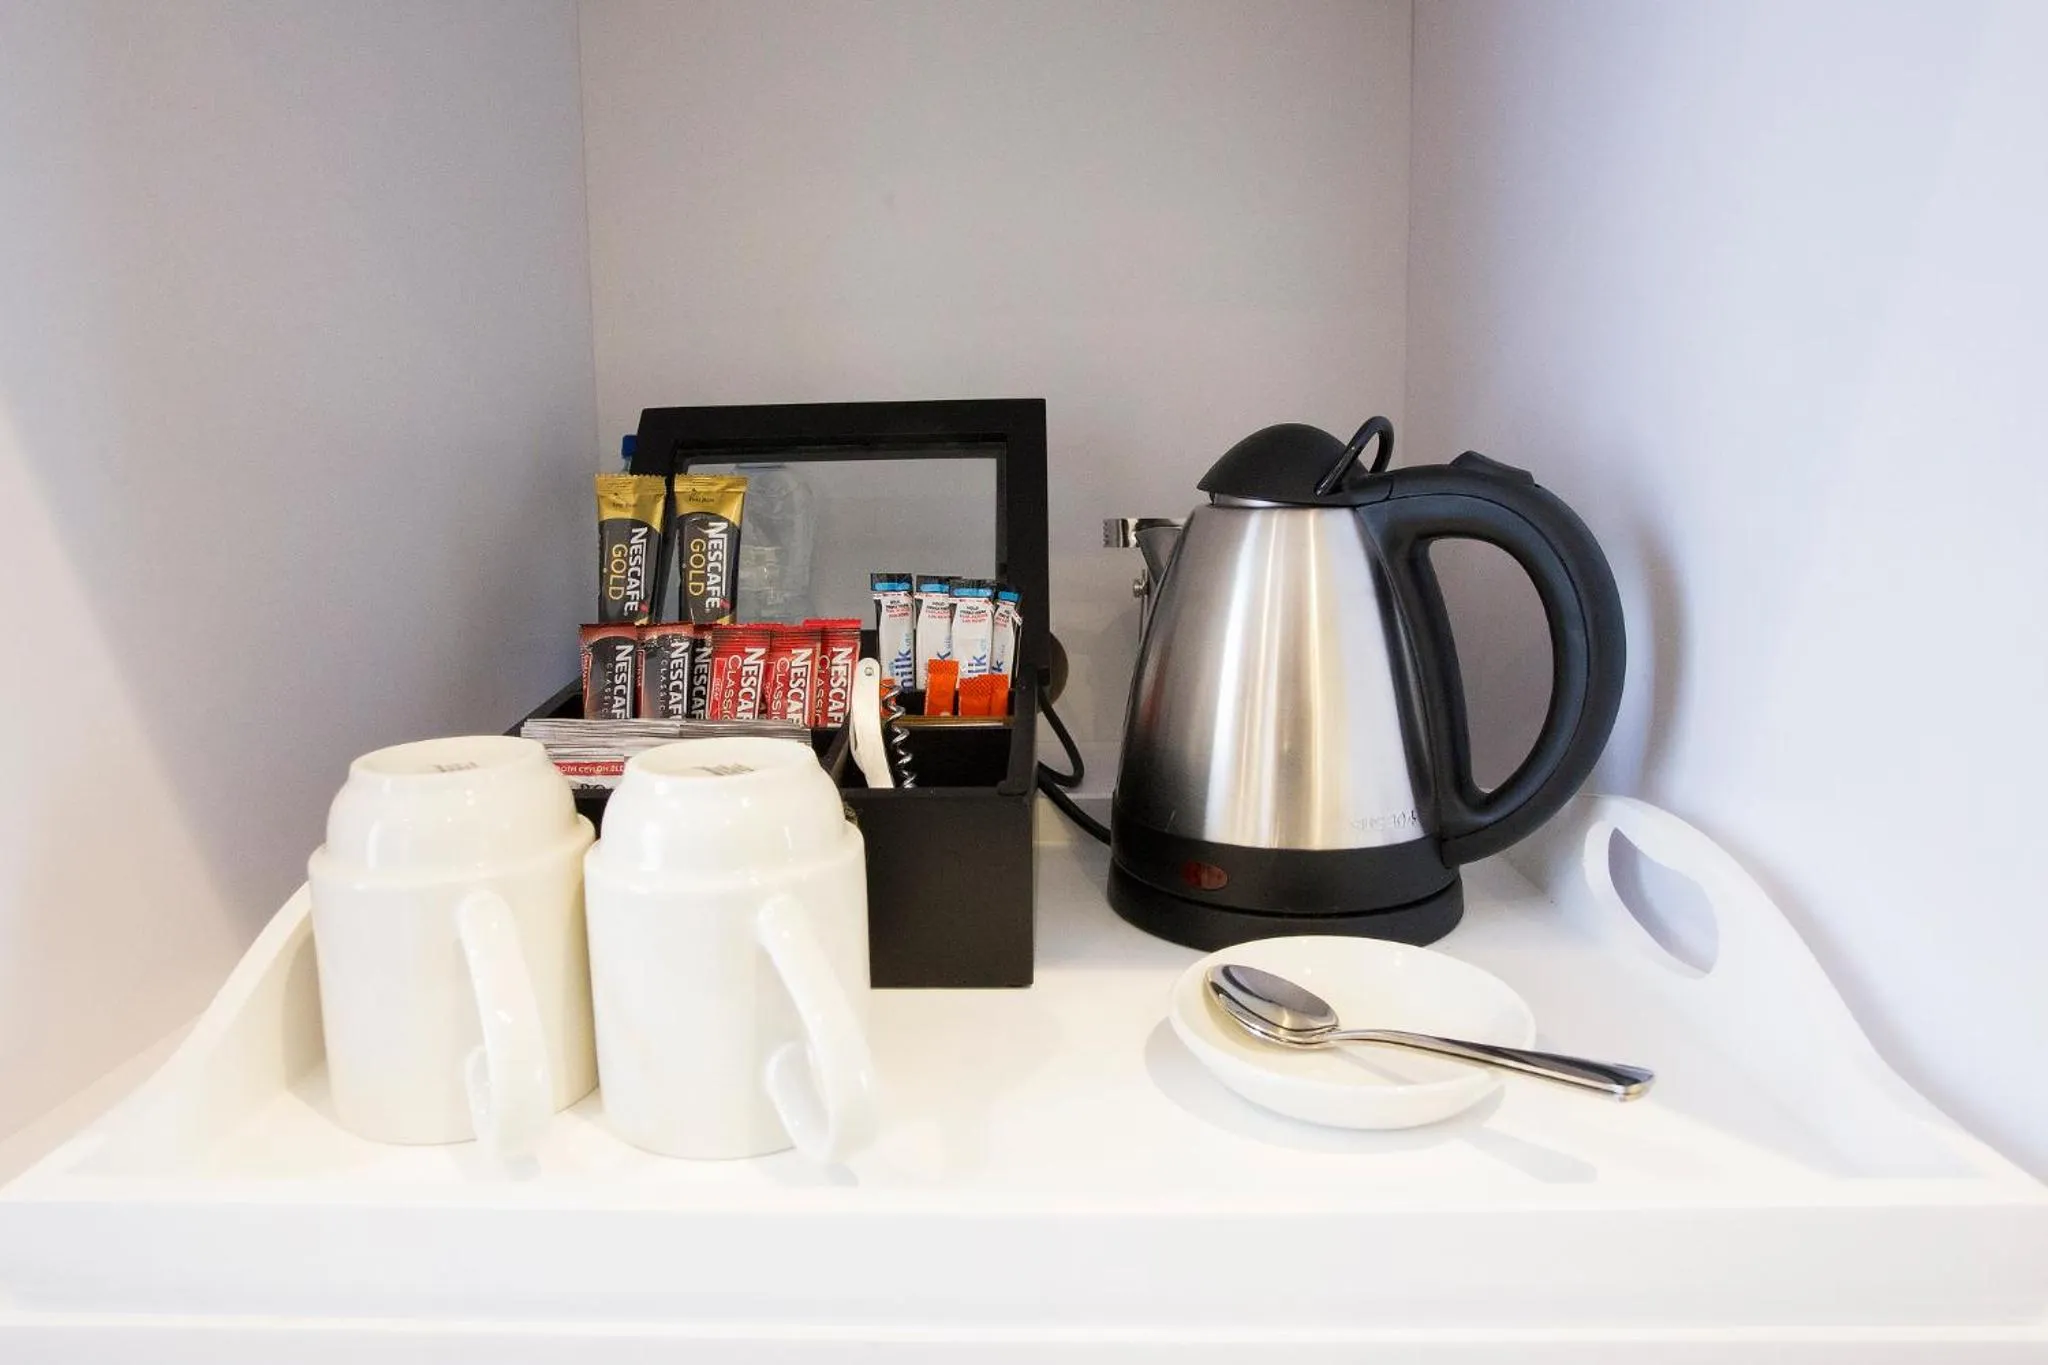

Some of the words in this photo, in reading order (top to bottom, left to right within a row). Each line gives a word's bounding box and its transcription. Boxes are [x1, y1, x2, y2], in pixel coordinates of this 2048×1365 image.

[608, 543, 628, 600] GOLD
[689, 538, 706, 597] GOLD
[602, 662, 614, 714] CLASSIC
[611, 645, 634, 719] NESCAF
[659, 659, 669, 711] CLASSIC
[668, 639, 690, 720] NESCAF
[691, 647, 711, 719] NESCAF
[736, 647, 766, 720] NESCAF
[787, 648, 813, 725] NESCAF
